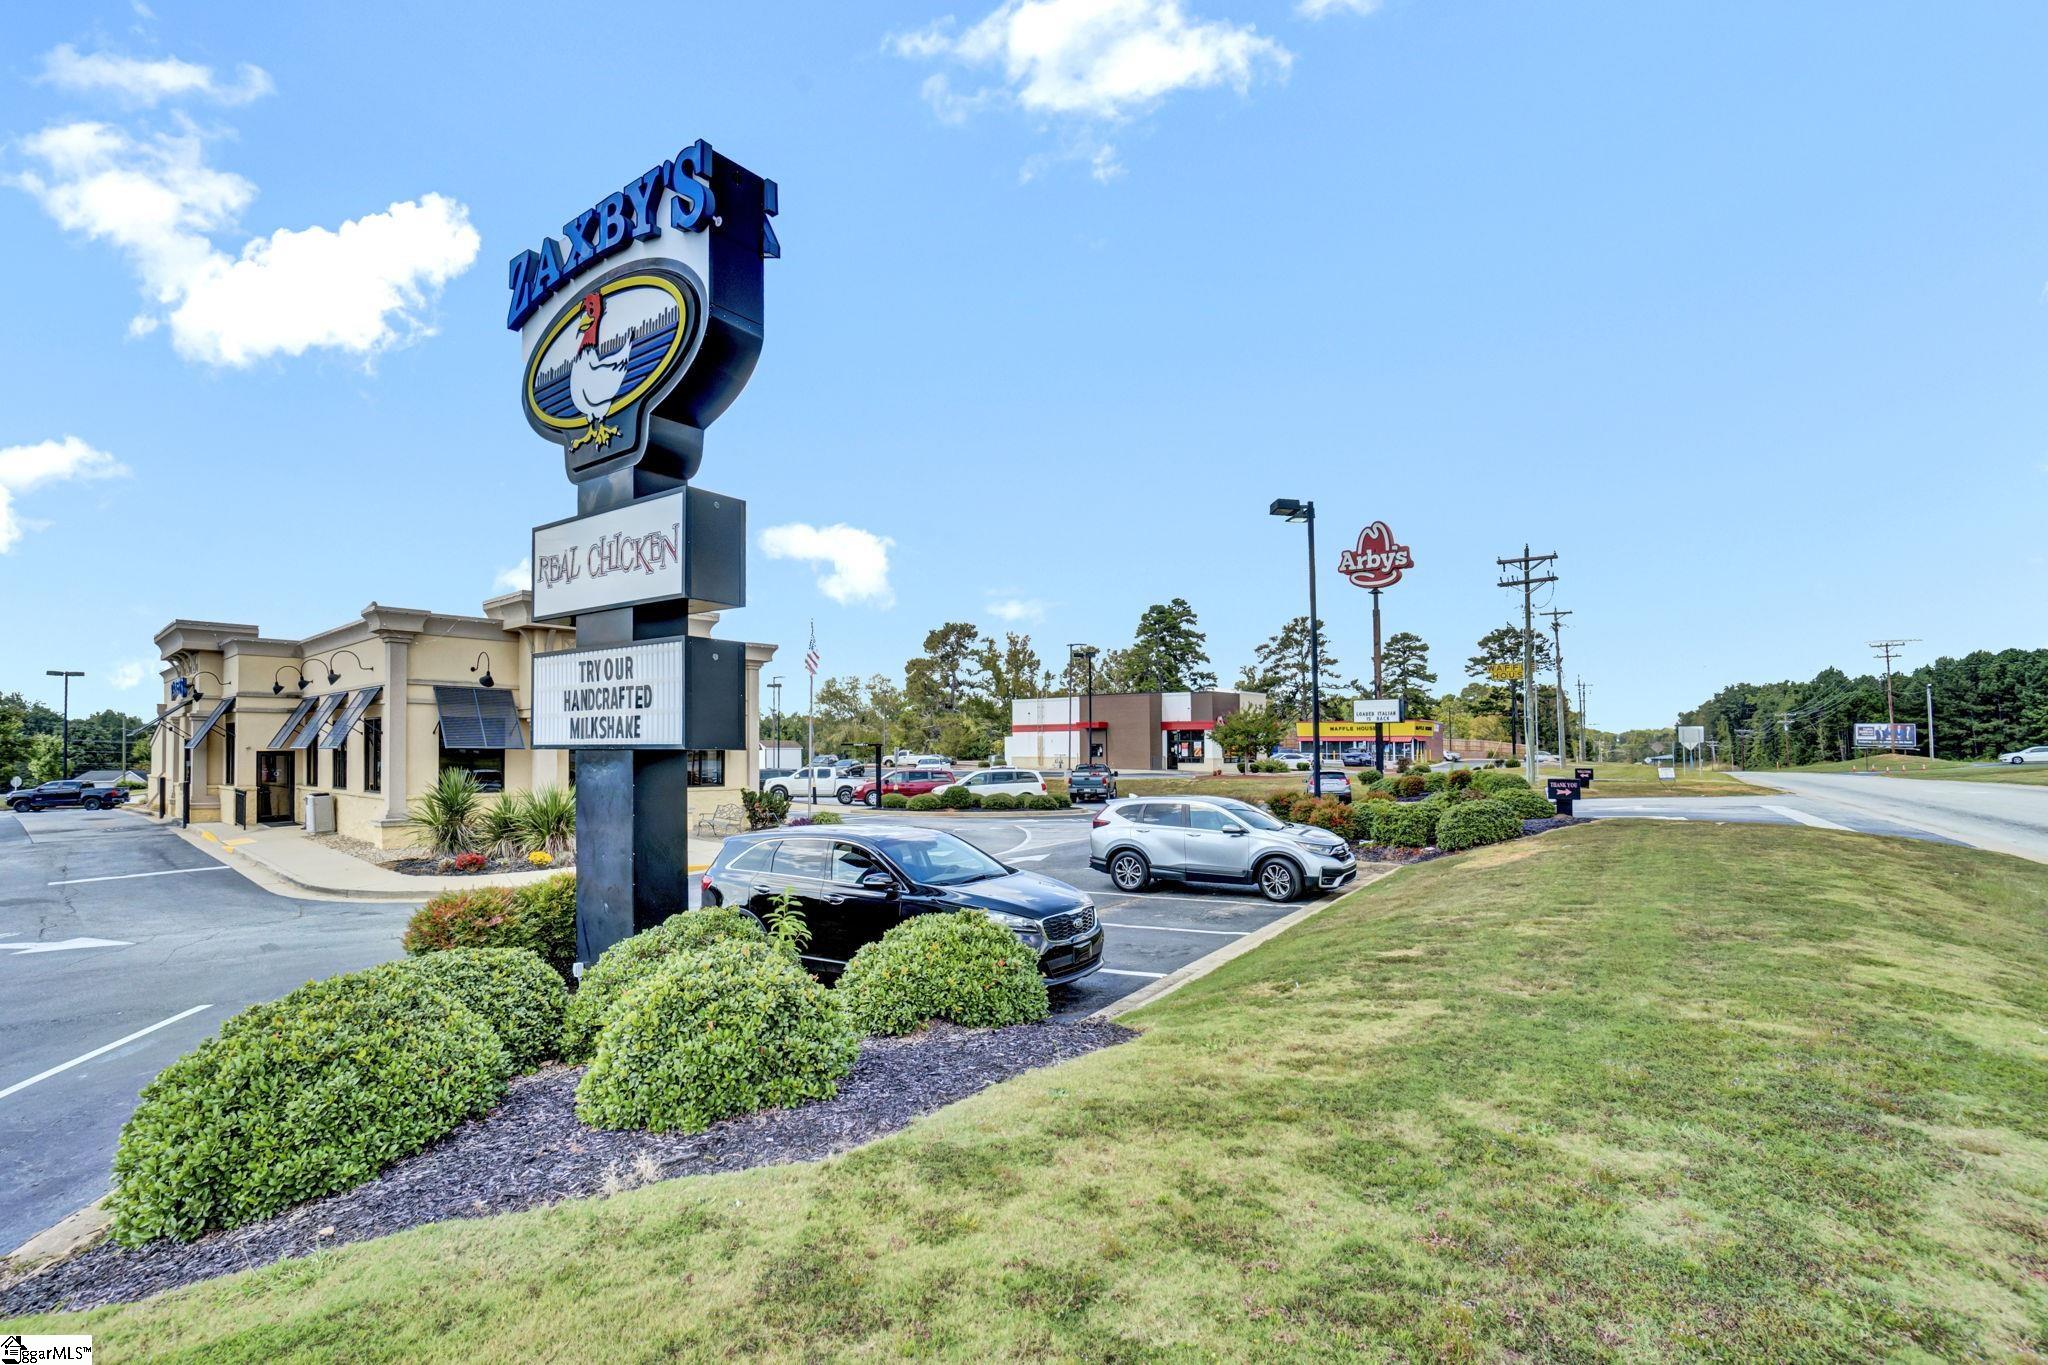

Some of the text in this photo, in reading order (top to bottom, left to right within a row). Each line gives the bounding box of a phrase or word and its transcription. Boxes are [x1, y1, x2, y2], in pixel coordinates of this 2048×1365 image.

[507, 138, 715, 331] ZAXBY'S
[537, 522, 681, 589] REAL CHICKEN
[1339, 545, 1408, 573] Arby's
[578, 656, 634, 683] TRY OUR
[563, 684, 653, 712] HANDCRAFTED
[570, 715, 641, 740] MILKSHAKE
